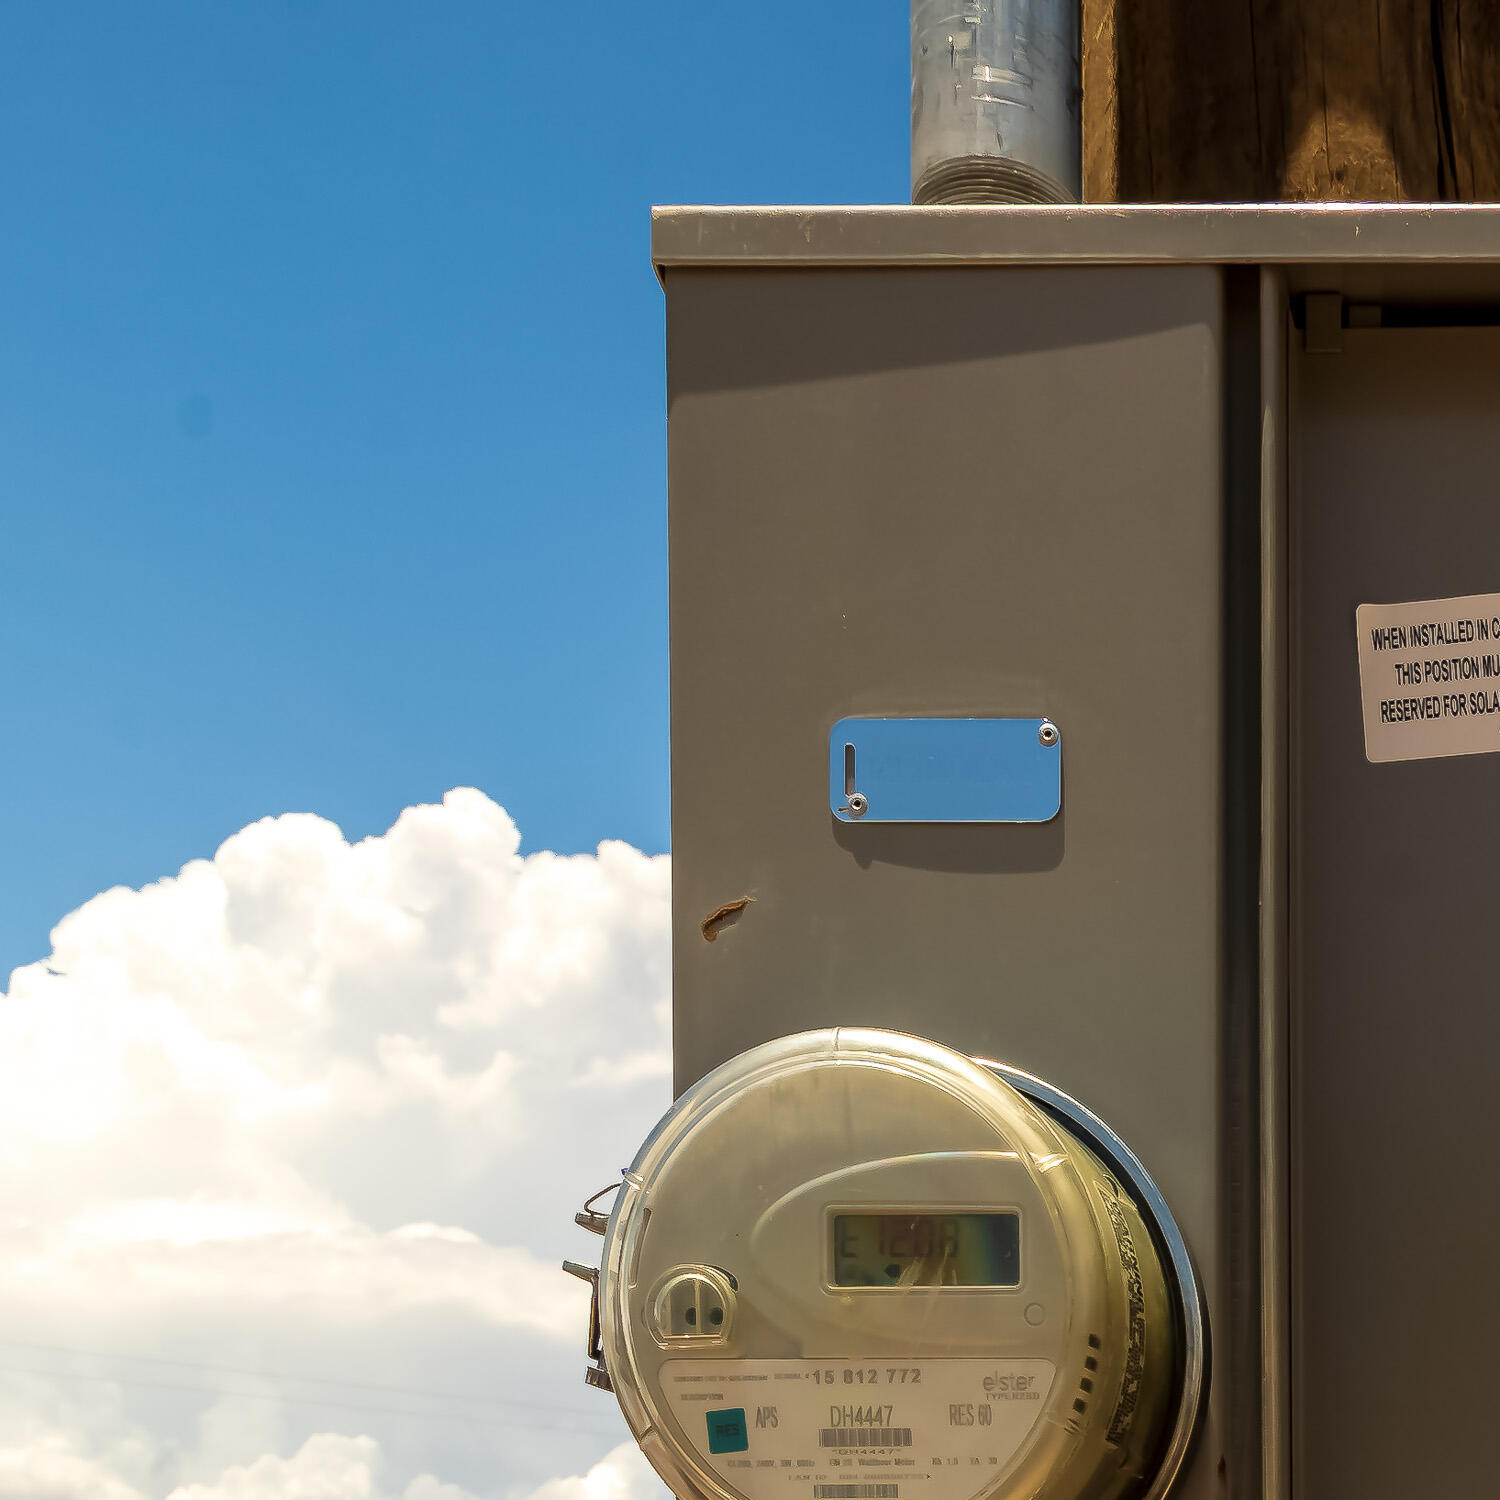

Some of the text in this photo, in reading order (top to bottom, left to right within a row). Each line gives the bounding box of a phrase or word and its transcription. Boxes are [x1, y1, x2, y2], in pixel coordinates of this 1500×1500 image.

[1371, 626, 1407, 651] WHEN
[1409, 620, 1474, 647] INSTALLED
[1477, 618, 1489, 640] IN
[1394, 661, 1421, 686] THIS
[1423, 656, 1480, 683] POSITION
[1380, 696, 1441, 723] RESERVED
[1443, 693, 1468, 717] FOR
[813, 1368, 1035, 1391] 15 812 772 elster
[755, 1405, 779, 1428] APS
[830, 1405, 894, 1427] DH4447
[949, 1403, 974, 1426] RES
